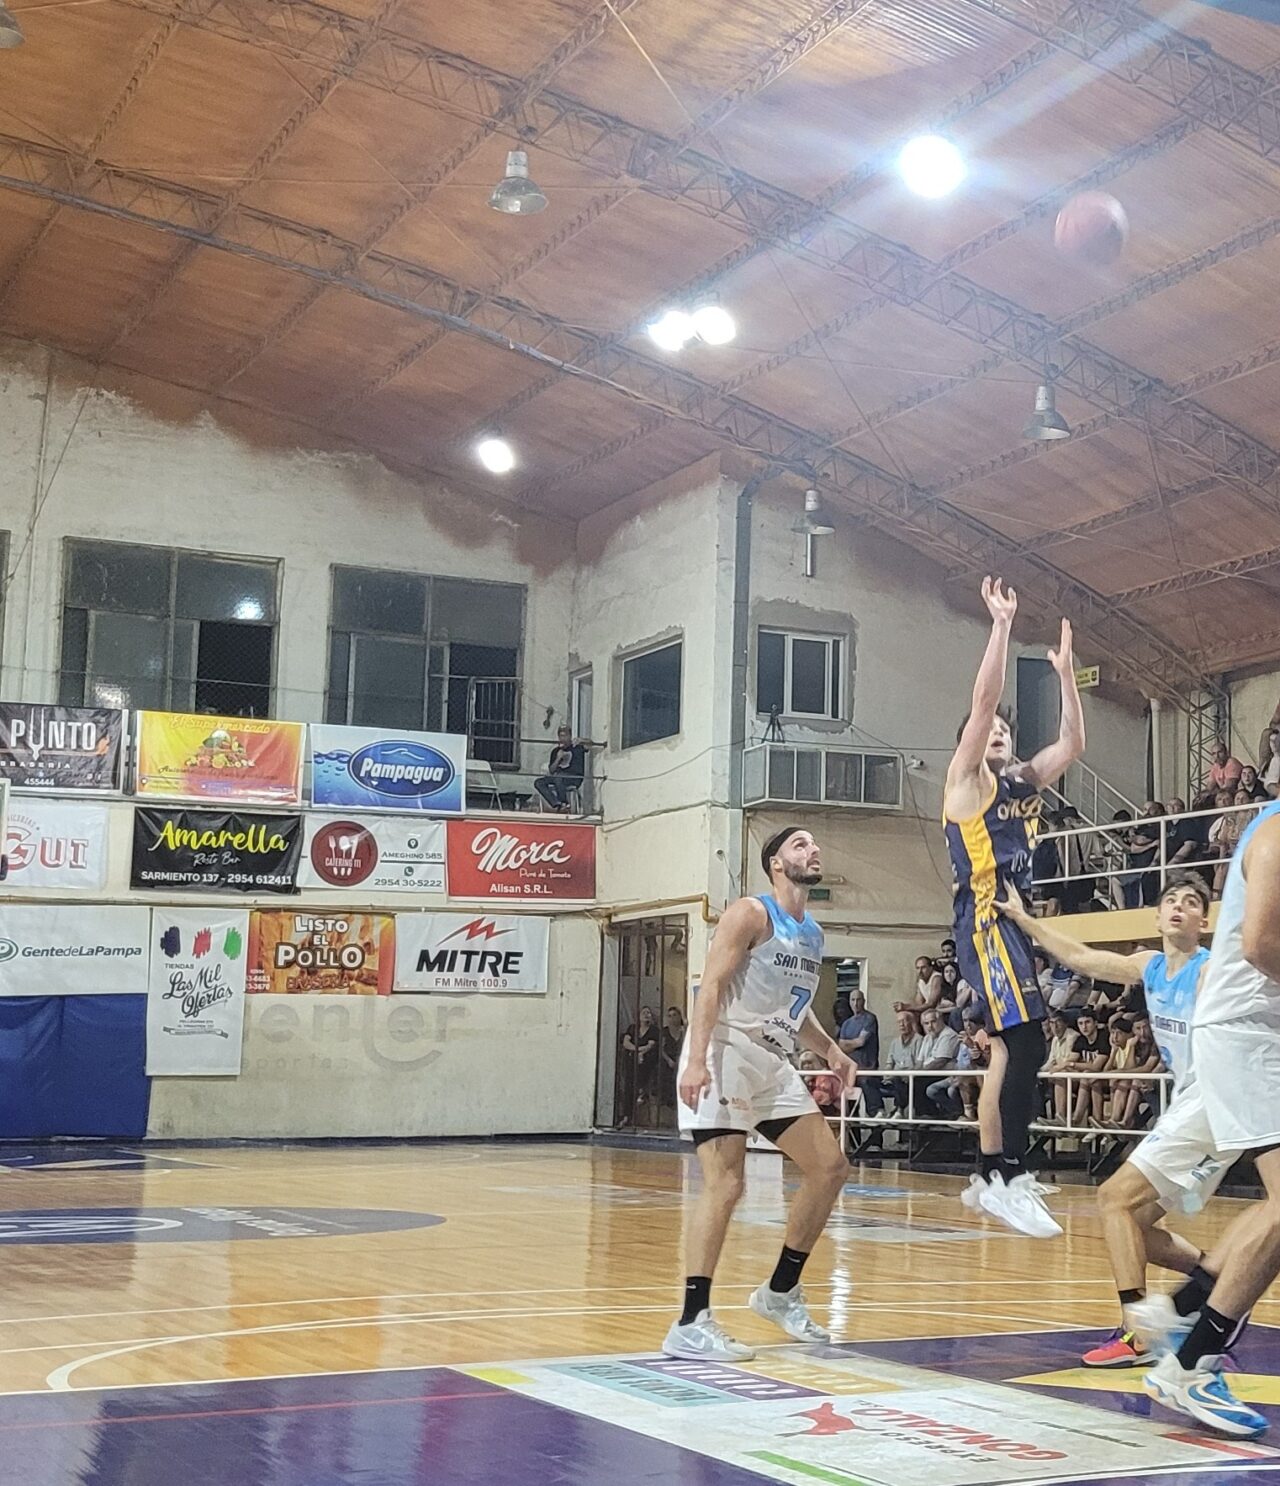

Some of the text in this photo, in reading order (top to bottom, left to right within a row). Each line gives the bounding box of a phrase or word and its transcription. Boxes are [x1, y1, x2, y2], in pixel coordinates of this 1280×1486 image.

[10, 708, 97, 760] PUNTO
[360, 758, 445, 783] Pampagua
[148, 820, 289, 853] Amarella
[471, 827, 571, 874] Mora
[141, 871, 200, 882] SARMIENTO
[202, 873, 219, 882] 137
[227, 873, 253, 884] 2954
[255, 875, 292, 885] 612411
[375, 878, 442, 888] 2954 30-5222
[490, 883, 553, 894] Alisan S.R.L.
[313, 934, 329, 946] EL
[276, 944, 364, 969] POLLO
[415, 949, 524, 977] MITRE
[774, 952, 798, 969] SAN
[162, 964, 222, 999] Las Mil
[435, 978, 508, 988] FM Mitre 100.9
[789, 985, 811, 1021] 7
[851, 1408, 1068, 1460] GONZALO
[888, 1432, 997, 1463] EXPRESO
